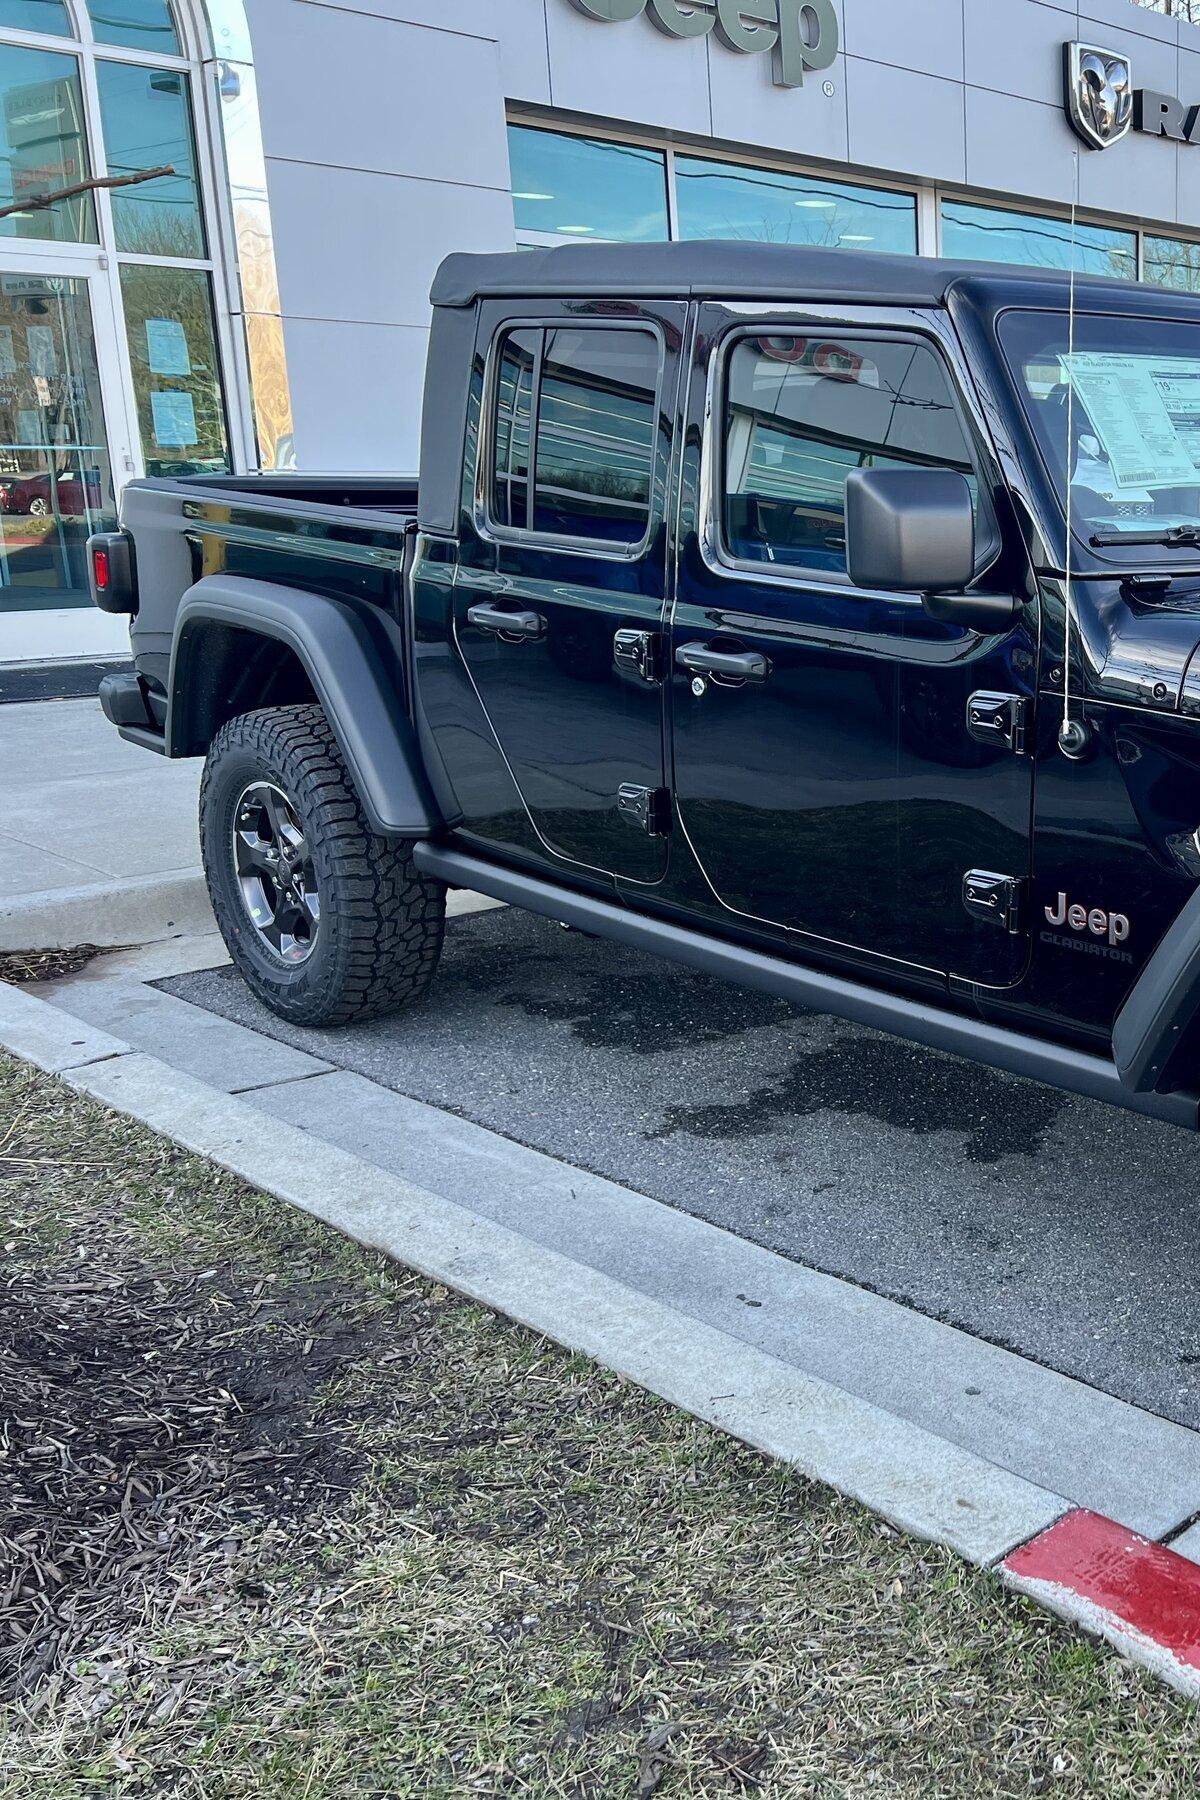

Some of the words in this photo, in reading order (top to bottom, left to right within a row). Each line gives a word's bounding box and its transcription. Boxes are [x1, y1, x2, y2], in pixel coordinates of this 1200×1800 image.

[567, 0, 839, 88] ep
[1044, 891, 1130, 946] Jeep
[1039, 930, 1134, 965] GLADIATOR
